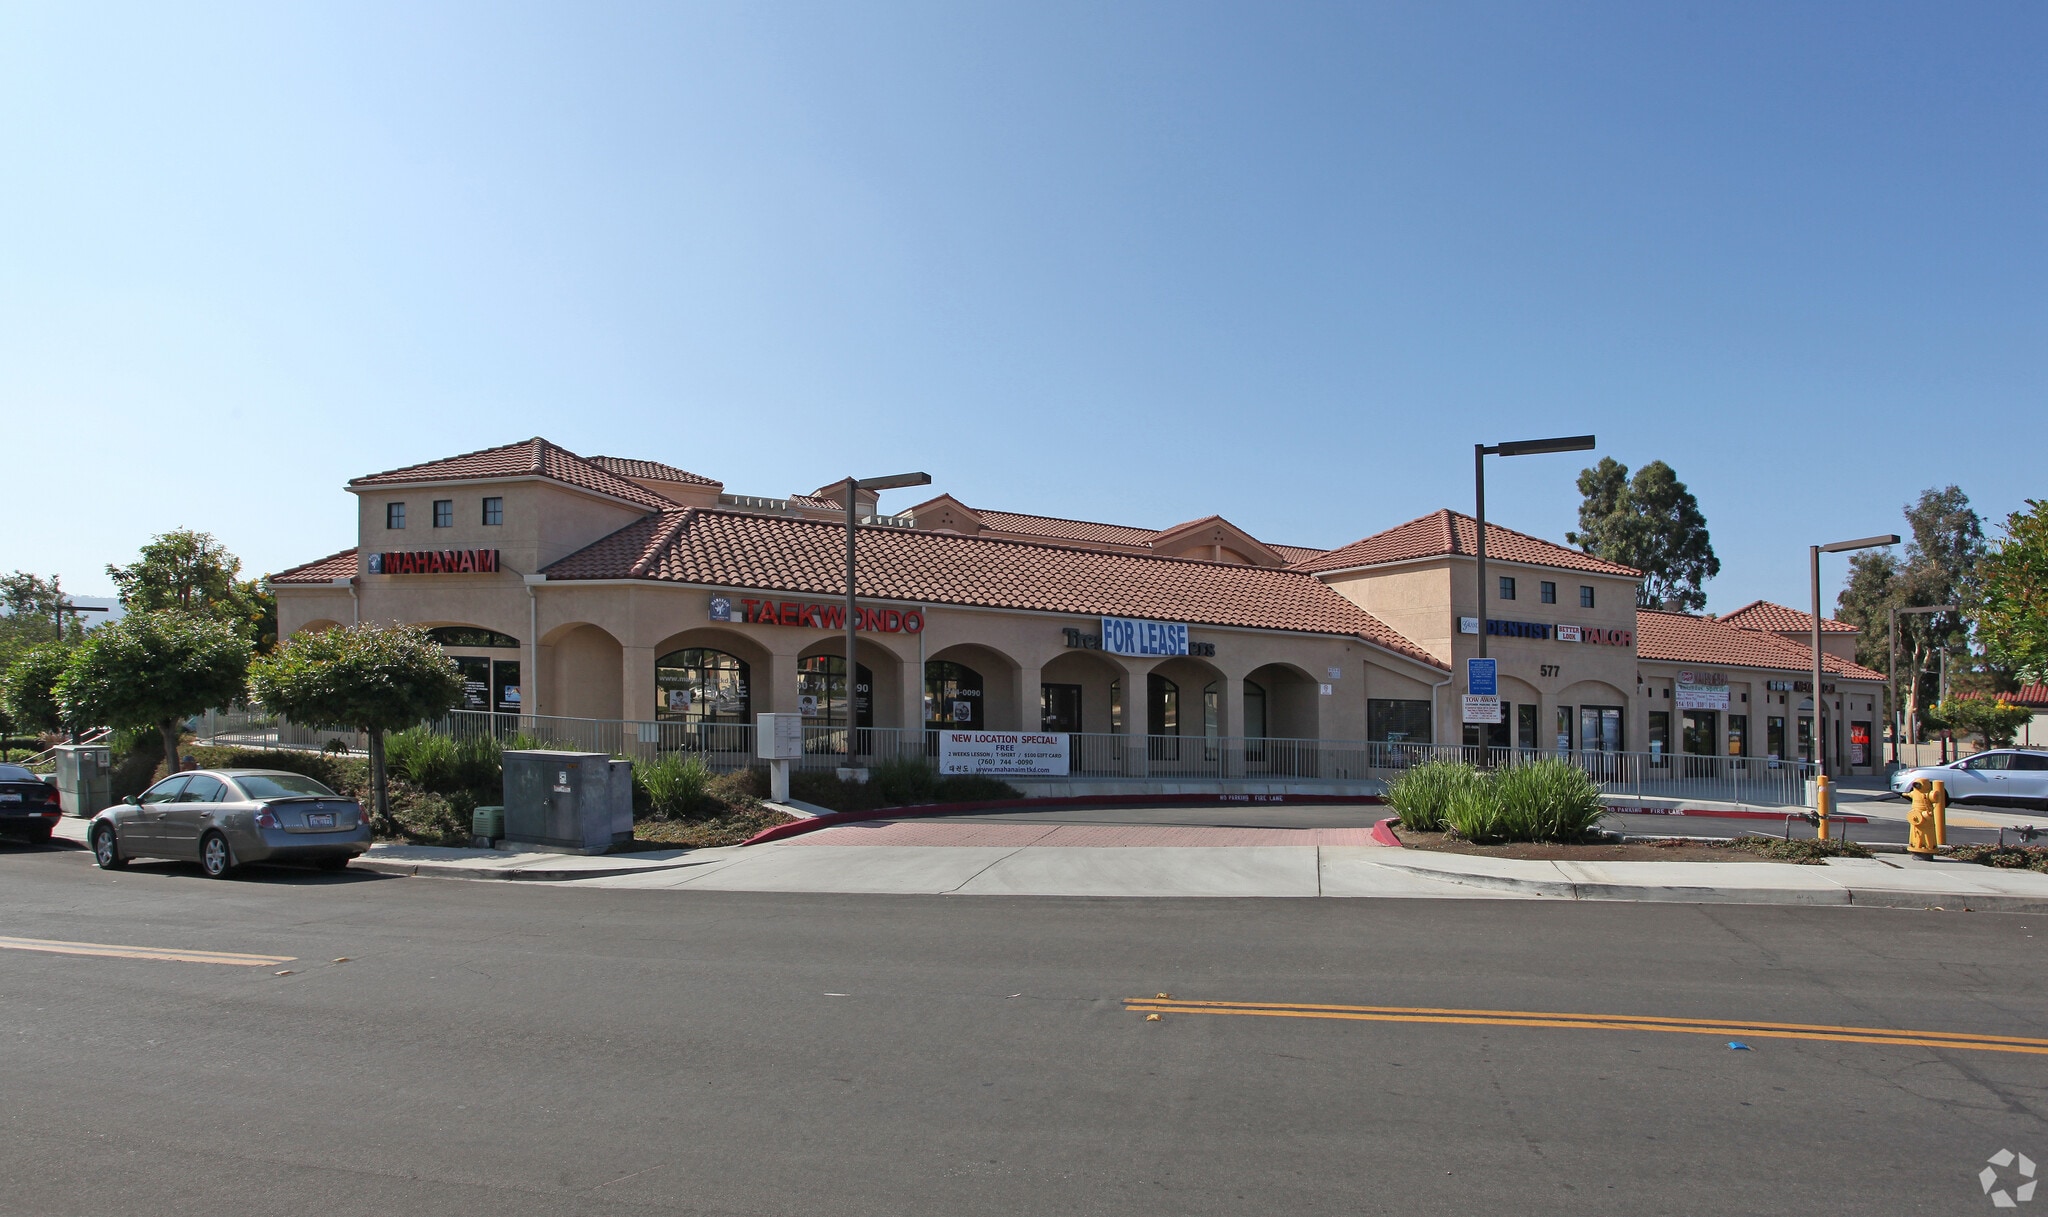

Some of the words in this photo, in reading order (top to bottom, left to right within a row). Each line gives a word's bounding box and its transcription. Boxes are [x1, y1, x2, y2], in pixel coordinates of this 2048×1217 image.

[383, 549, 498, 574] MAHANAIM
[741, 599, 925, 634] TAEKWONDO
[1103, 619, 1135, 653] FOR
[1138, 623, 1187, 656] LEASE
[1486, 619, 1553, 639] DENTIST
[1558, 625, 1580, 634] BETTER
[1562, 632, 1577, 640] LOOK
[1582, 627, 1633, 647] TAILOR
[1188, 641, 1216, 657] ers
[1540, 665, 1560, 677] 577
[952, 734, 972, 743] NEW
[975, 735, 1018, 744] LOCATION
[1021, 735, 1058, 745] SPECIAL!
